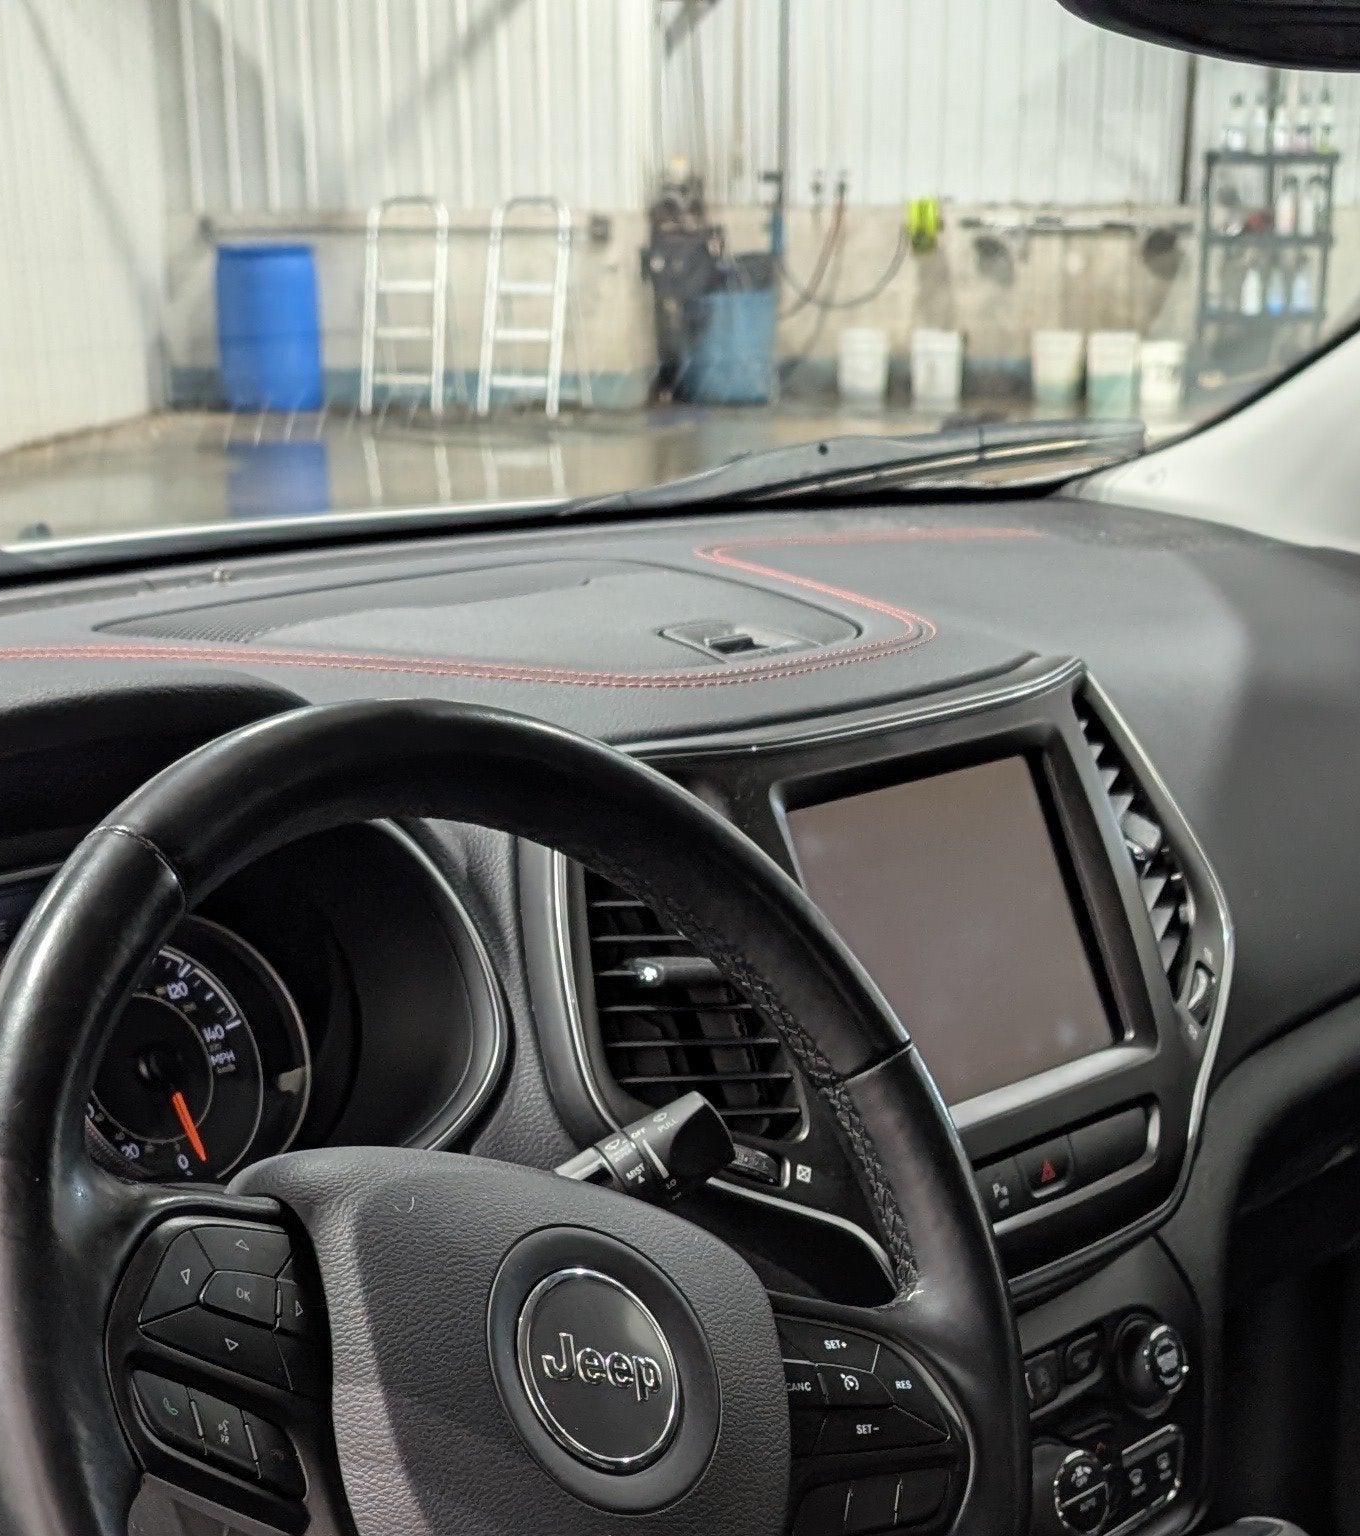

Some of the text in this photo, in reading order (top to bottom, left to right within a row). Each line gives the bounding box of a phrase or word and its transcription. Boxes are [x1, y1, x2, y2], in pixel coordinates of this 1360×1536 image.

[202, 1024, 225, 1042] 140
[208, 1050, 236, 1067] MPH
[657, 1118, 680, 1133] PULL
[121, 1143, 140, 1160] 20
[176, 1154, 189, 1170] 0
[626, 1163, 646, 1180] MIST
[236, 1287, 251, 1302] OK
[541, 1332, 663, 1402] Jeep
[895, 1380, 912, 1390] RES
